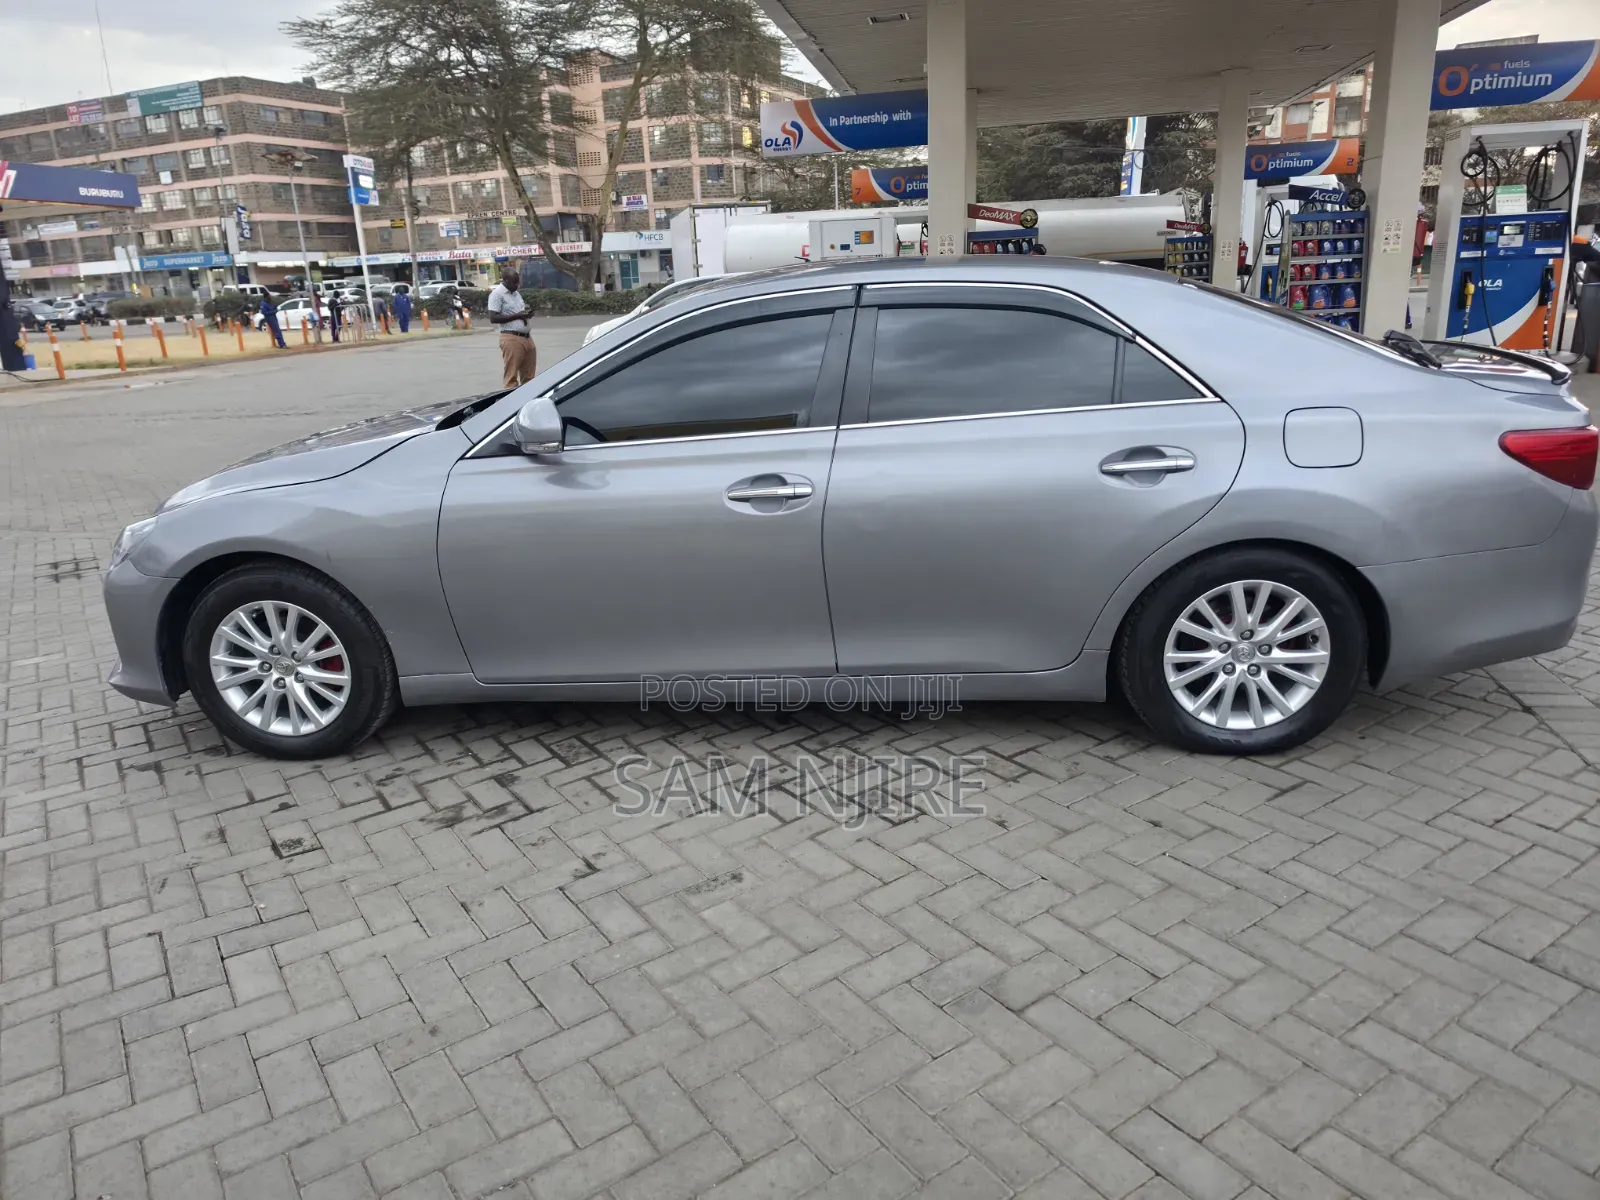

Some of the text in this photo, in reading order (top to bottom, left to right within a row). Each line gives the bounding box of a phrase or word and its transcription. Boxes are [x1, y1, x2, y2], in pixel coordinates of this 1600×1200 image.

[1504, 59, 1531, 69] fuels
[67, 105, 78, 113] TO
[69, 114, 80, 122] LET
[829, 110, 912, 127] In Partnership with
[764, 137, 792, 148] OLA
[1346, 157, 1355, 166] 2
[889, 175, 929, 194] Optim
[79, 187, 124, 199] BURUBURU
[855, 187, 862, 196] 7
[1309, 189, 1344, 203] Accel
[491, 209, 516, 217] CENTRE
[979, 209, 1017, 222] DeoMAX
[497, 247, 538, 256] BUTCHERY
[555, 244, 583, 252] BUTCHERY
[448, 250, 472, 260] Bata
